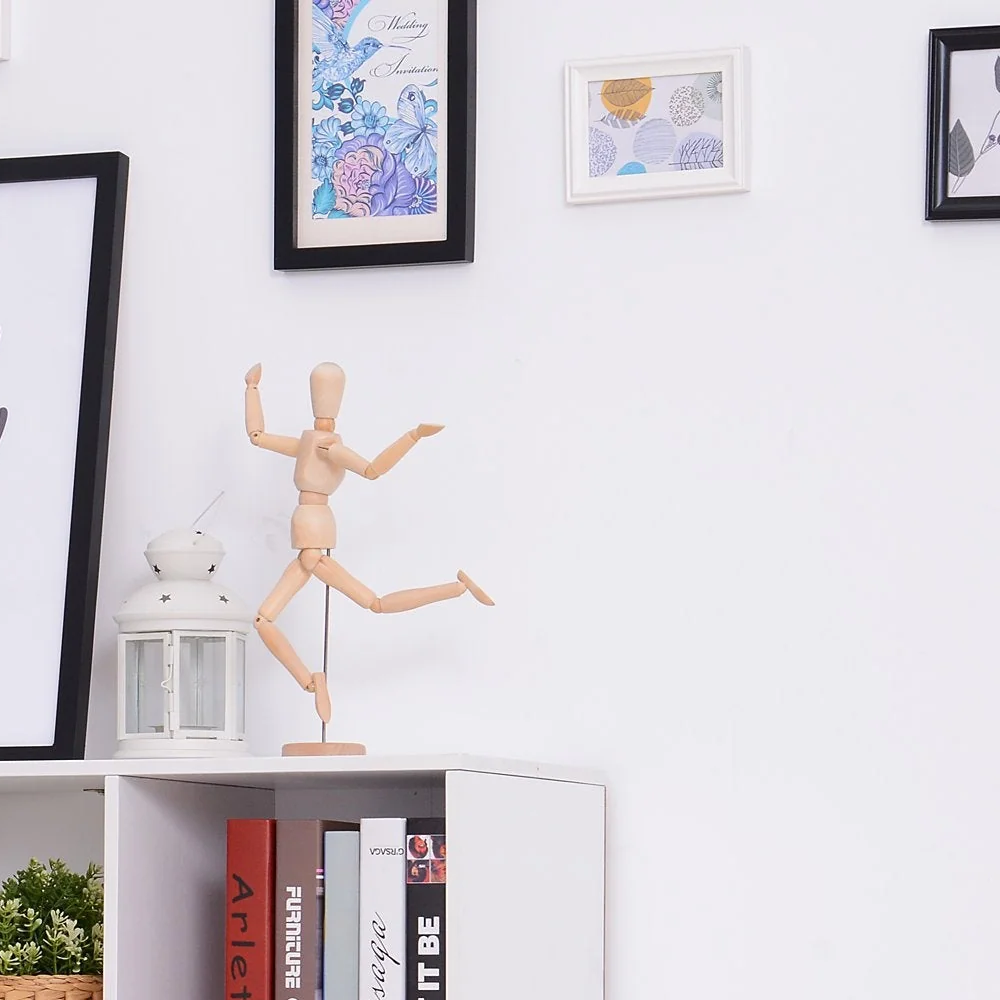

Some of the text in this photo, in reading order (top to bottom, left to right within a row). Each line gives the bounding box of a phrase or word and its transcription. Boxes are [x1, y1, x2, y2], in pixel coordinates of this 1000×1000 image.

[368, 12, 430, 43] Wedding
[370, 53, 438, 77] Invitation
[417, 915, 440, 956] BE
[417, 963, 440, 991] IT
